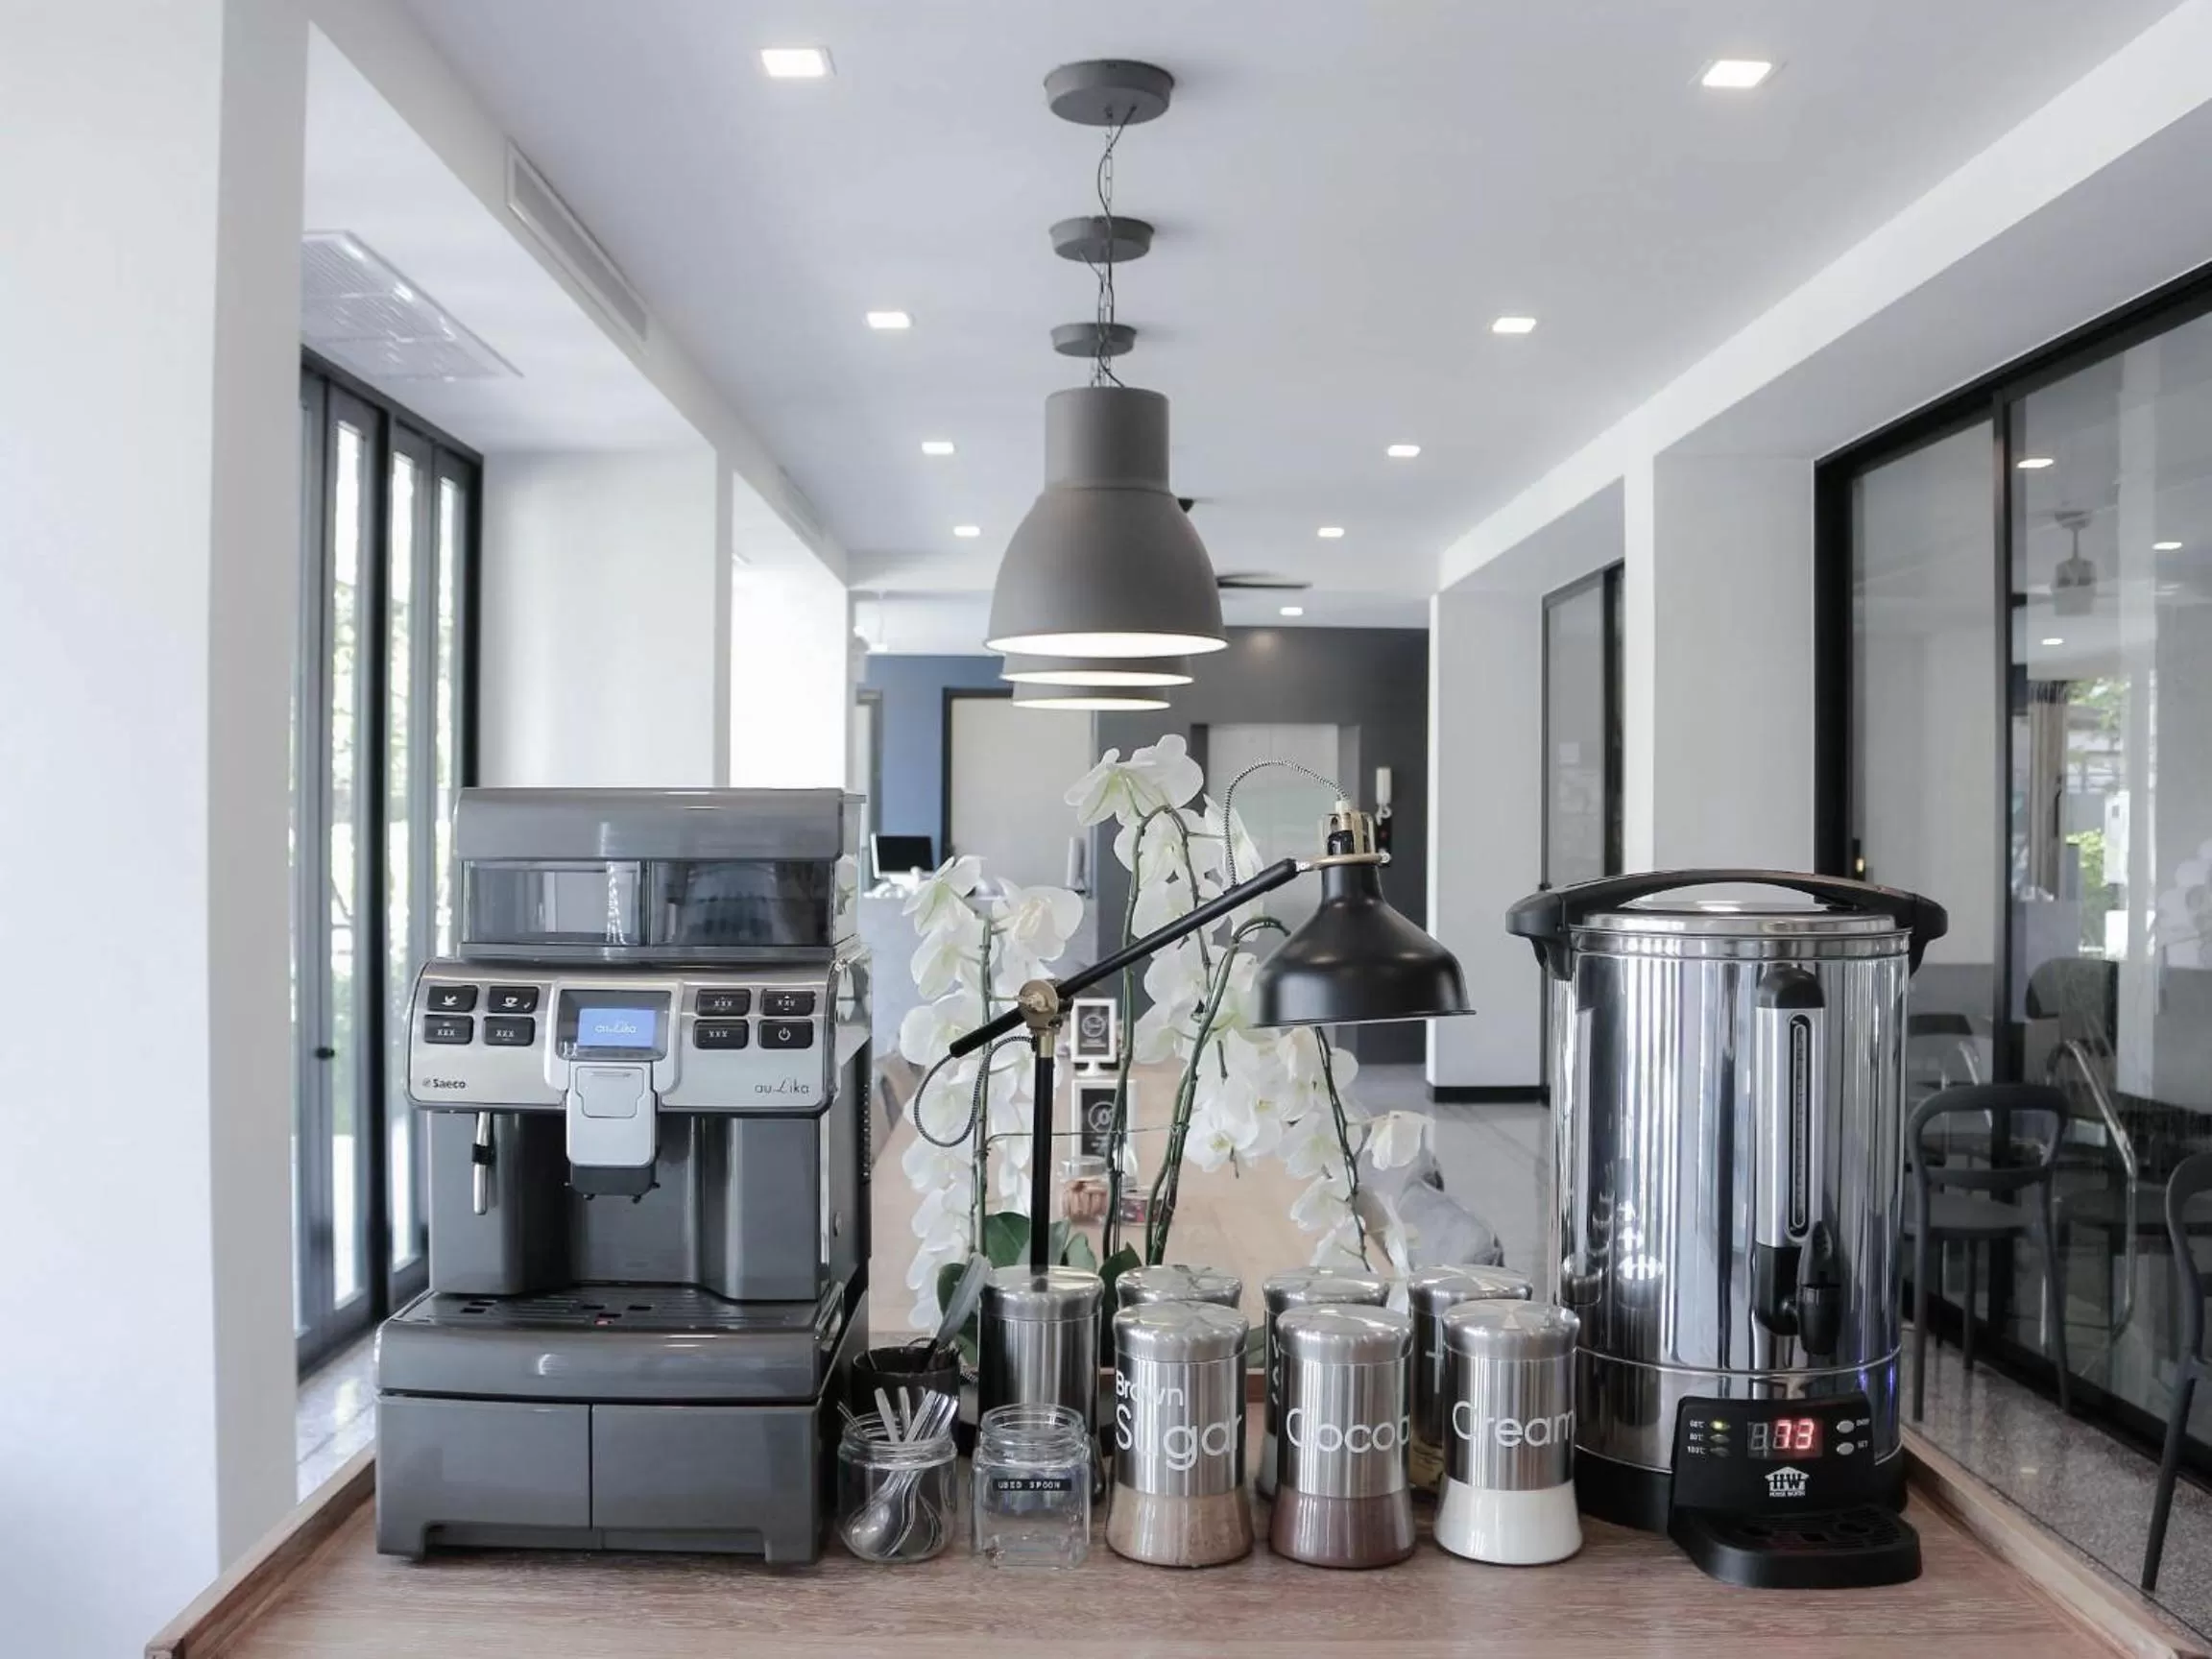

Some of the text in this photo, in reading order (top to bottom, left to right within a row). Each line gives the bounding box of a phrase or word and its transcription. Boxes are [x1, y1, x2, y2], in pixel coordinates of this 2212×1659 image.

[432, 1078, 467, 1090] Saeco
[1116, 1403, 1243, 1471] Sugar
[1028, 1480, 1061, 1490] SPOON
